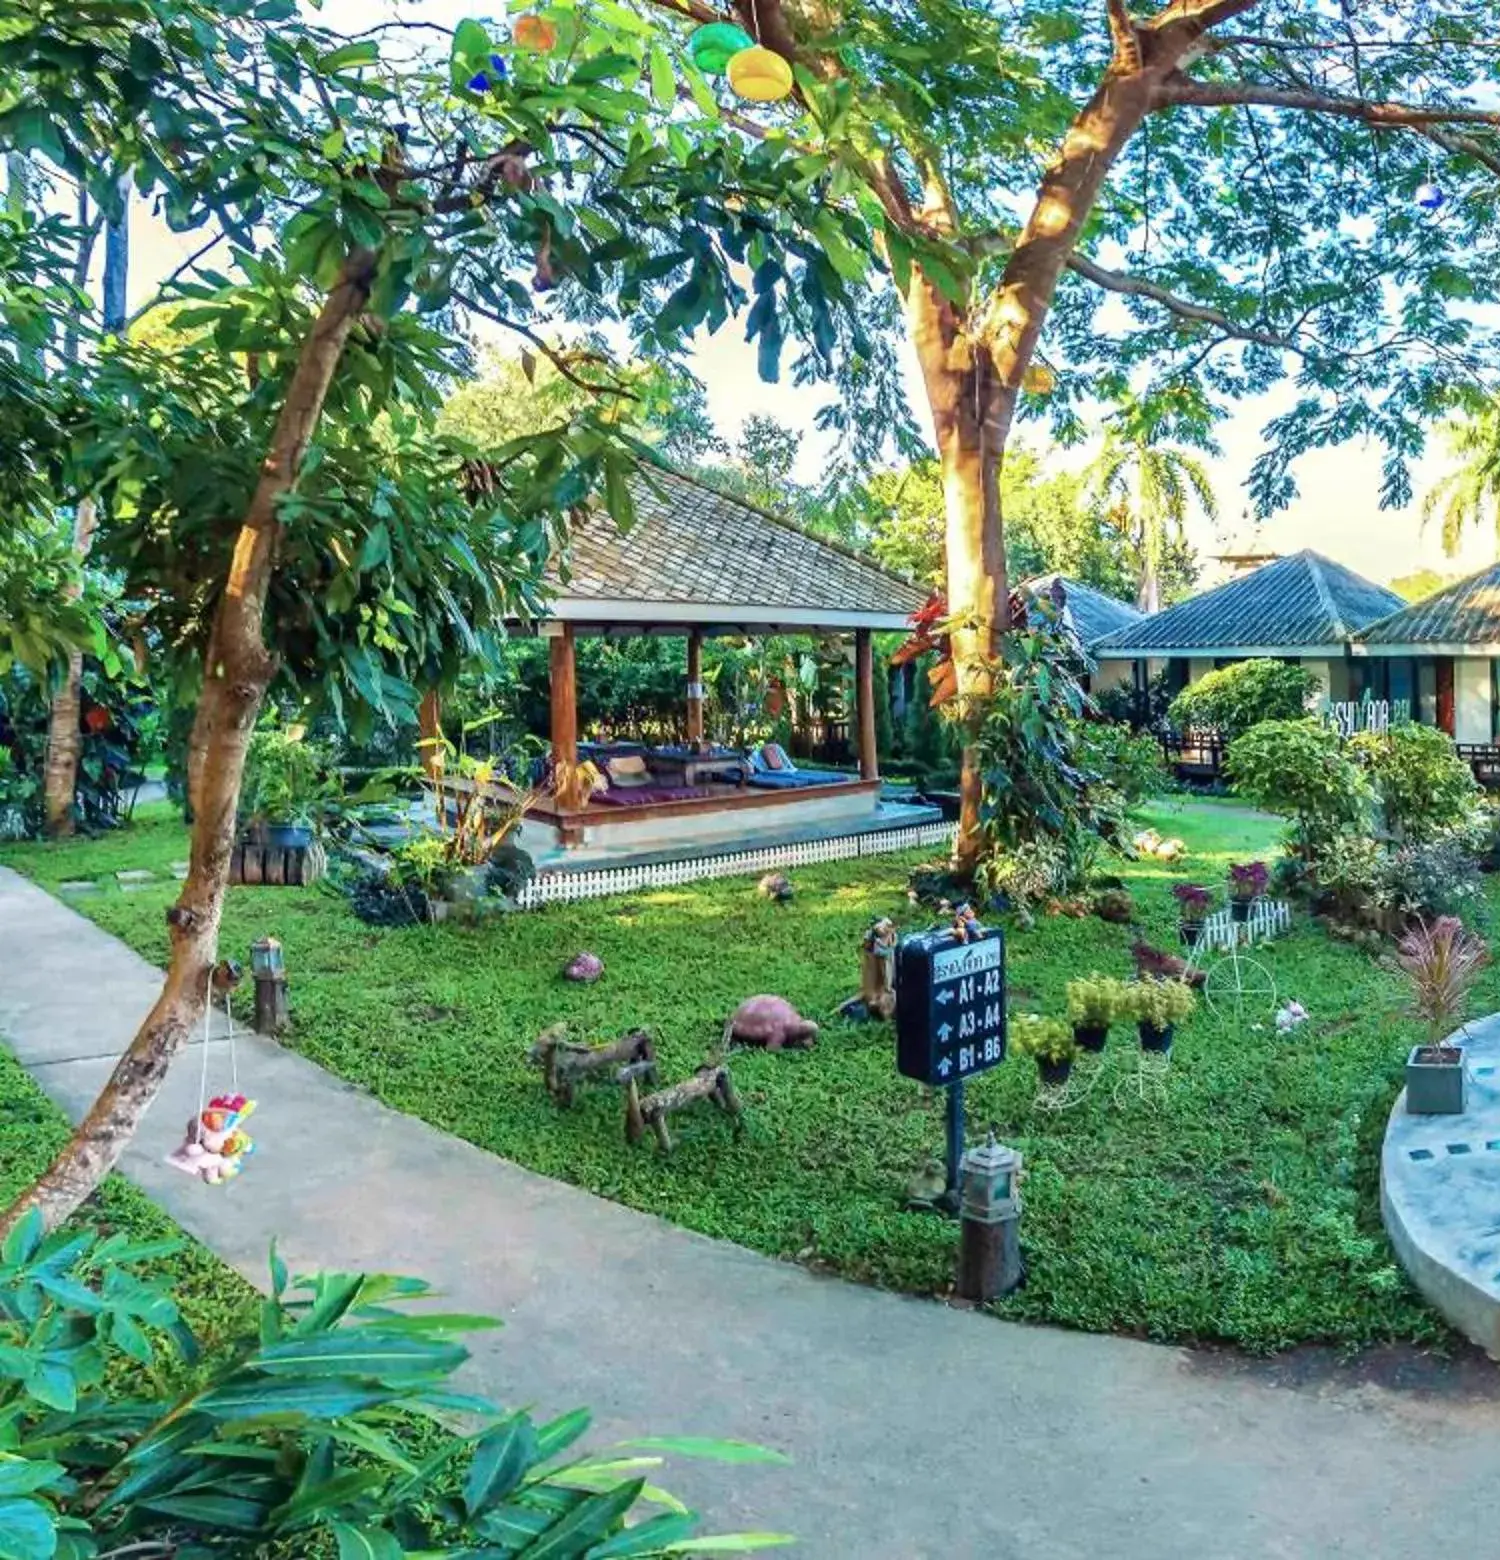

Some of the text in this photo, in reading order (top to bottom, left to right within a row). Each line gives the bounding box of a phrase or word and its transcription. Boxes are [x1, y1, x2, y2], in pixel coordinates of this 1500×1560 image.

[959, 977, 975, 1004] A1
[984, 969, 1000, 997] A2
[959, 1011, 975, 1038] A3
[984, 1002, 1000, 1030] A4
[959, 1044, 975, 1071] B1
